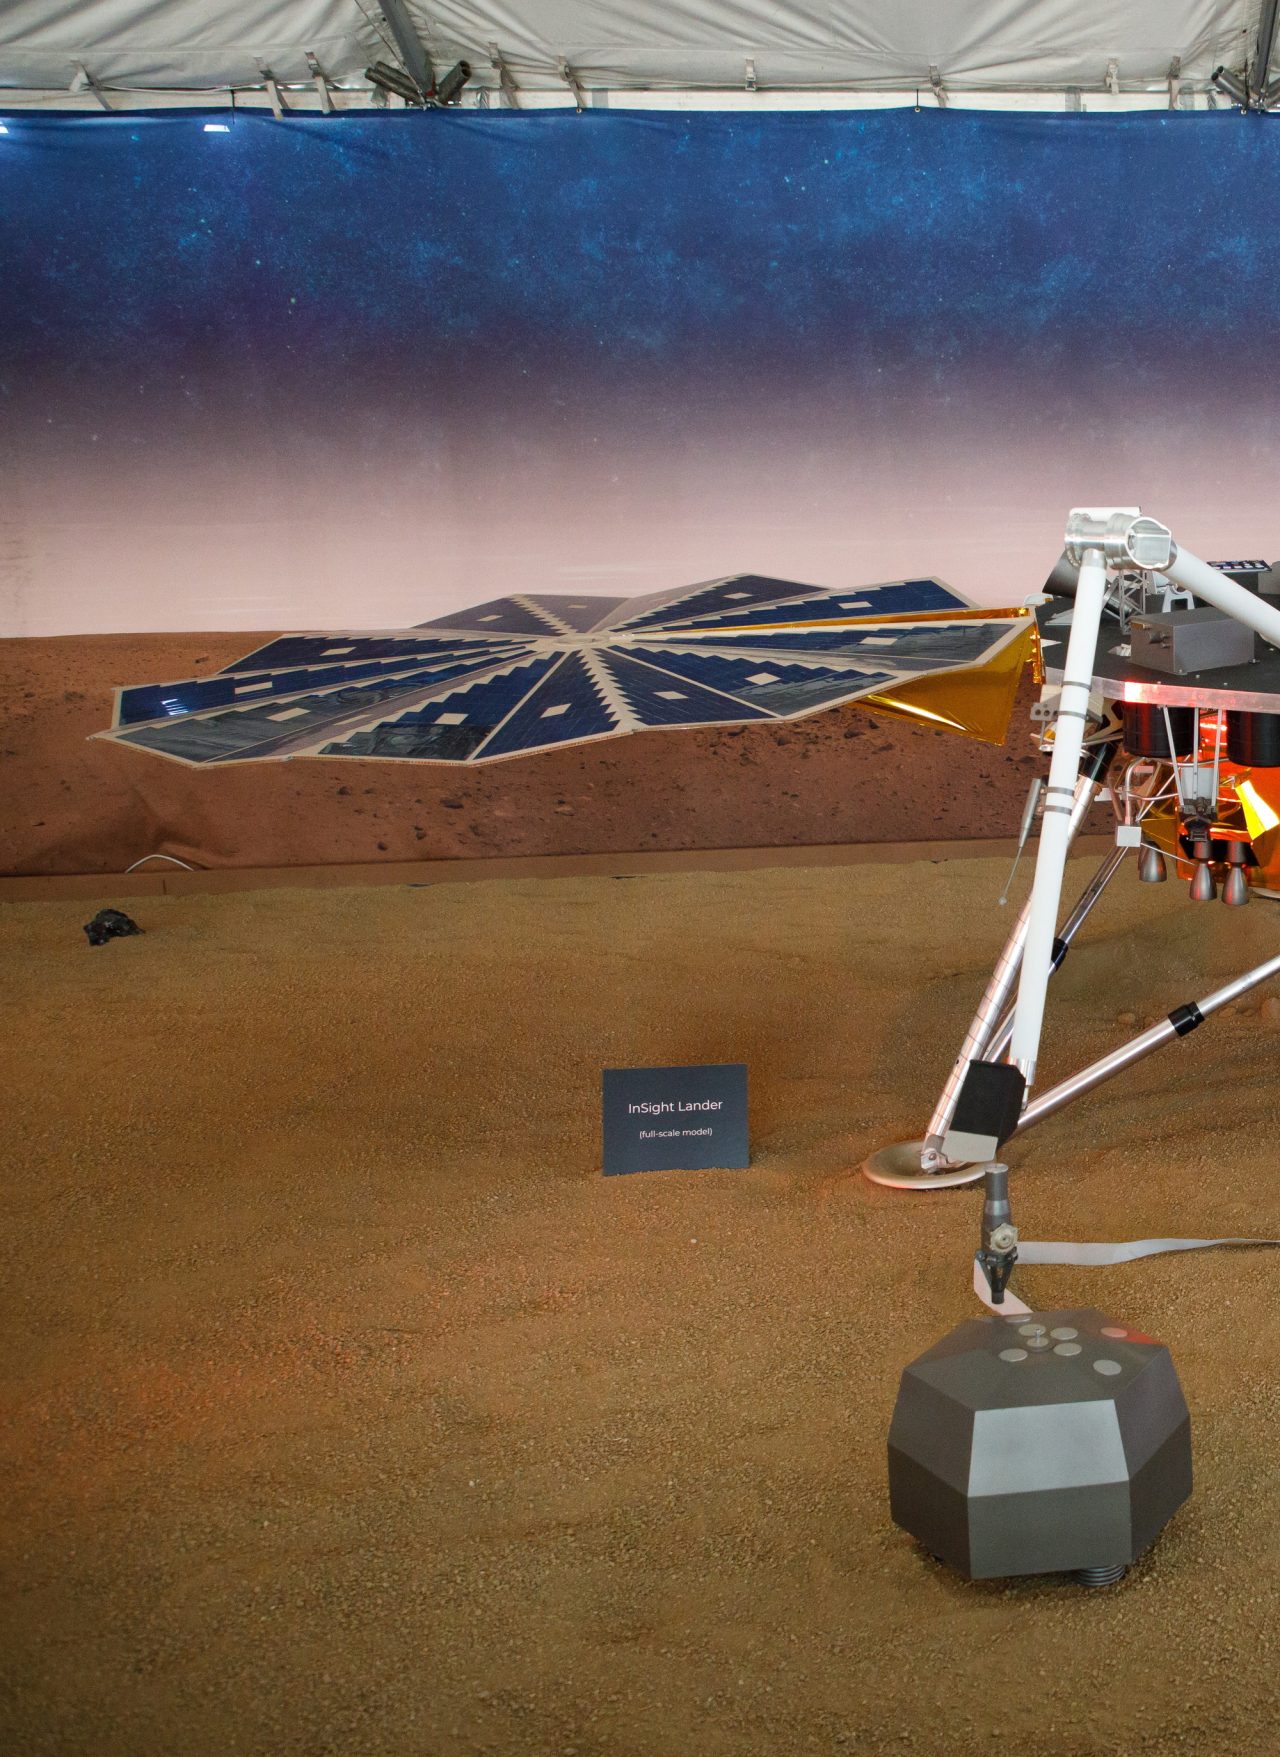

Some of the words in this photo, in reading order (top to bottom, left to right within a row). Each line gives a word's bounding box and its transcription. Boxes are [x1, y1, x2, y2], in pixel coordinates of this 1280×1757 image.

[628, 1101, 675, 1115] InSight
[678, 1100, 723, 1112] Lander
[639, 1129, 680, 1139] (full-scale
[682, 1128, 712, 1137] model)
